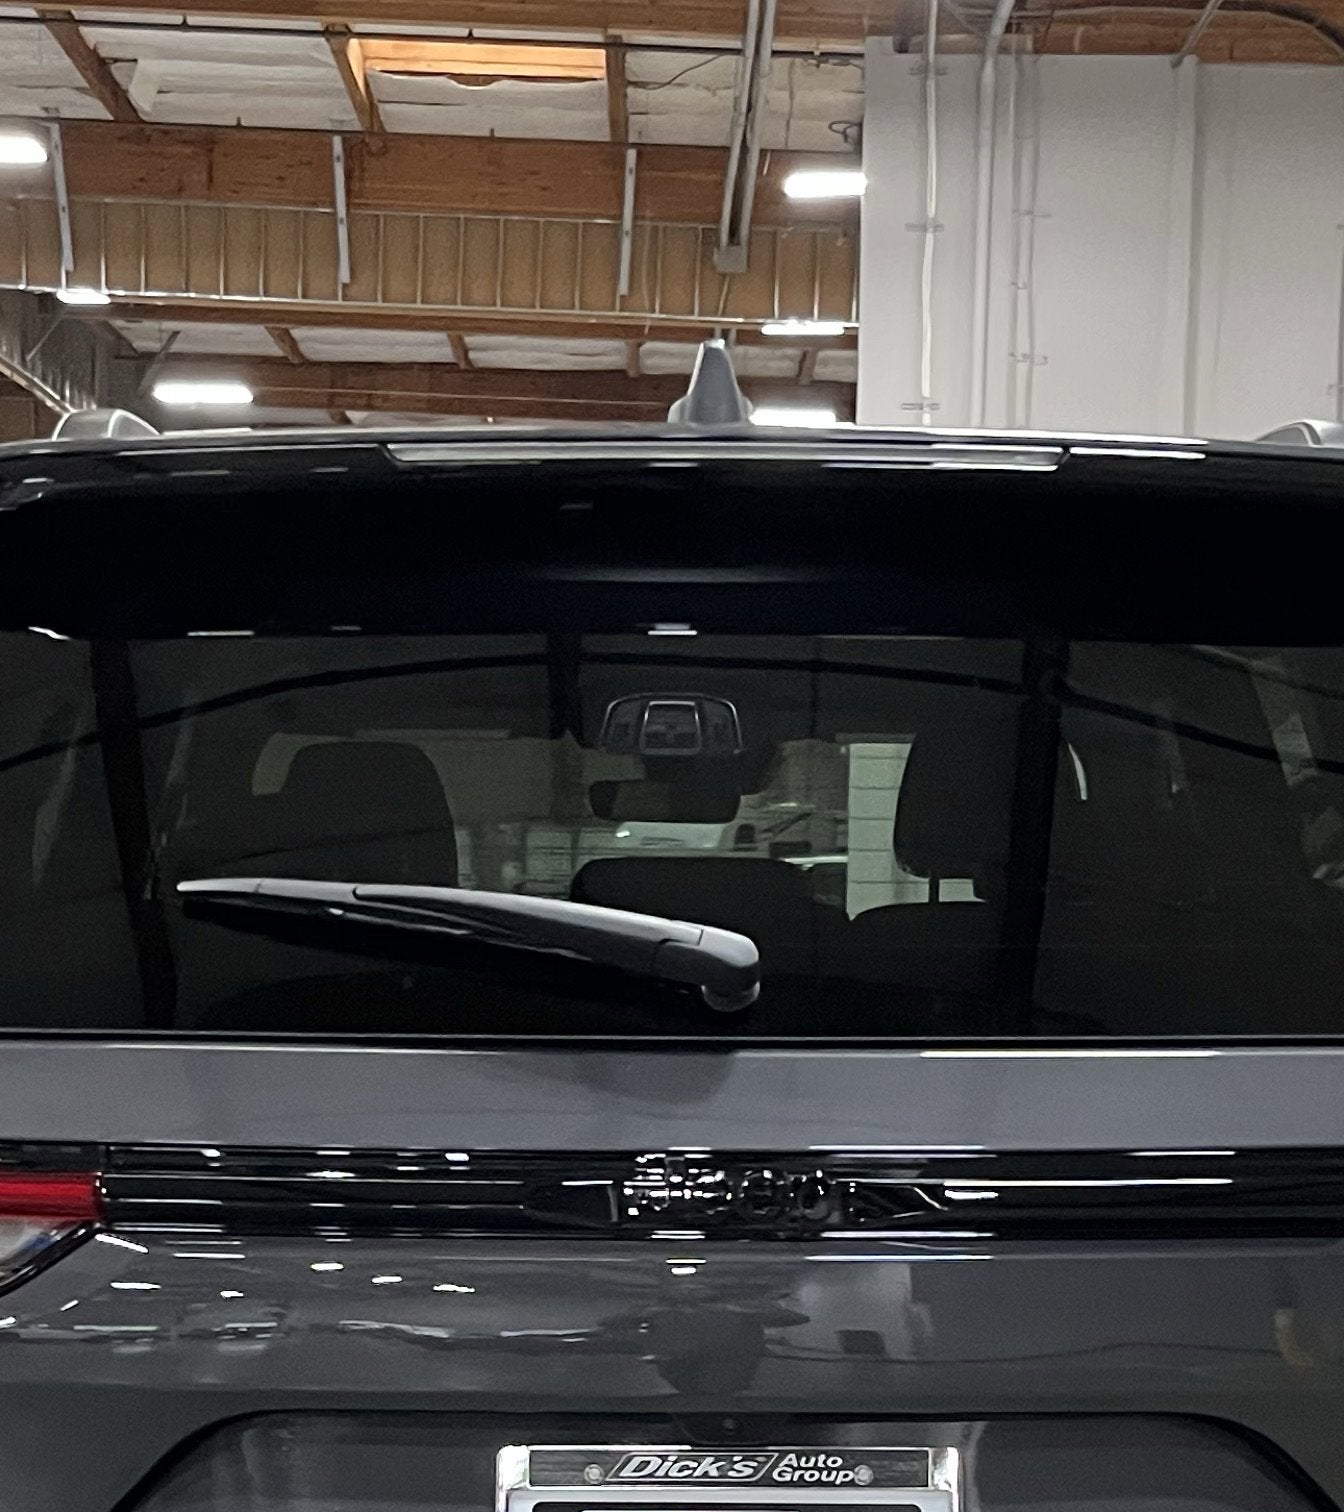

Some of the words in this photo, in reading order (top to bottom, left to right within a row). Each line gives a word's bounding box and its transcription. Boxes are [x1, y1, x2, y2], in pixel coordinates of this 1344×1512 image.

[618, 1455, 758, 1478] Dick's
[777, 1453, 843, 1468] Auto
[772, 1467, 855, 1485] Group
